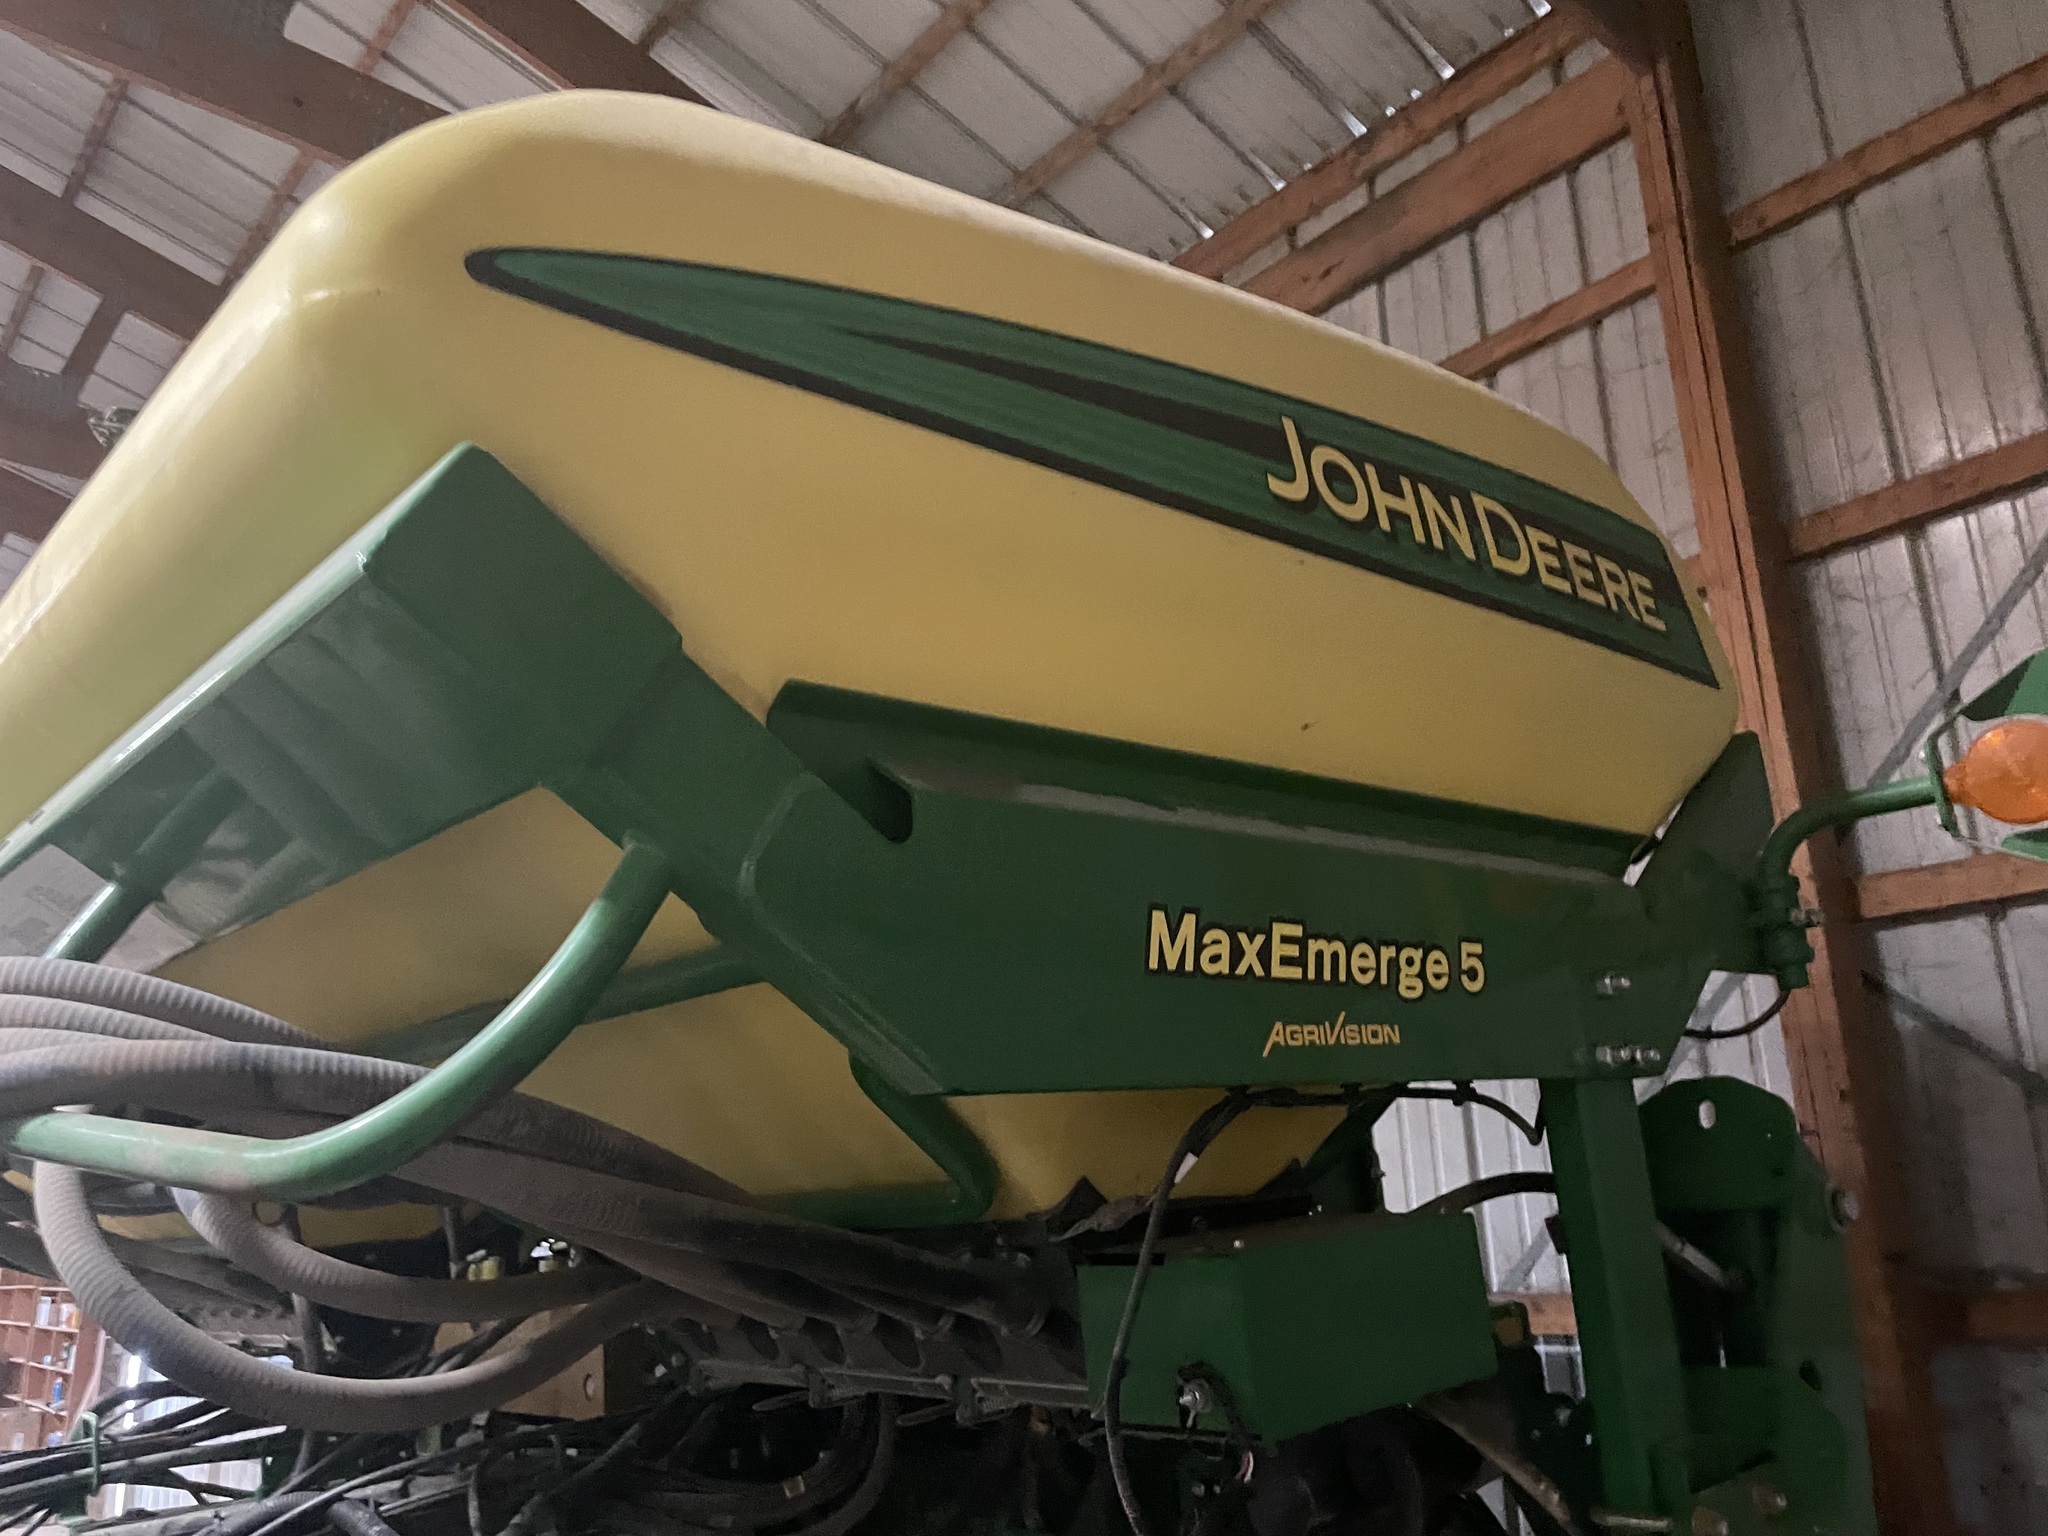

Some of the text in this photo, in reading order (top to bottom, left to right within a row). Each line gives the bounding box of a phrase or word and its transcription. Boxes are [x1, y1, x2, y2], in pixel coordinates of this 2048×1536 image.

[1267, 415, 1667, 632] JOHN DEERE
[1147, 907, 1486, 1000] MaxEmerge 5
[1262, 1010, 1401, 1058] AGRIVISION
